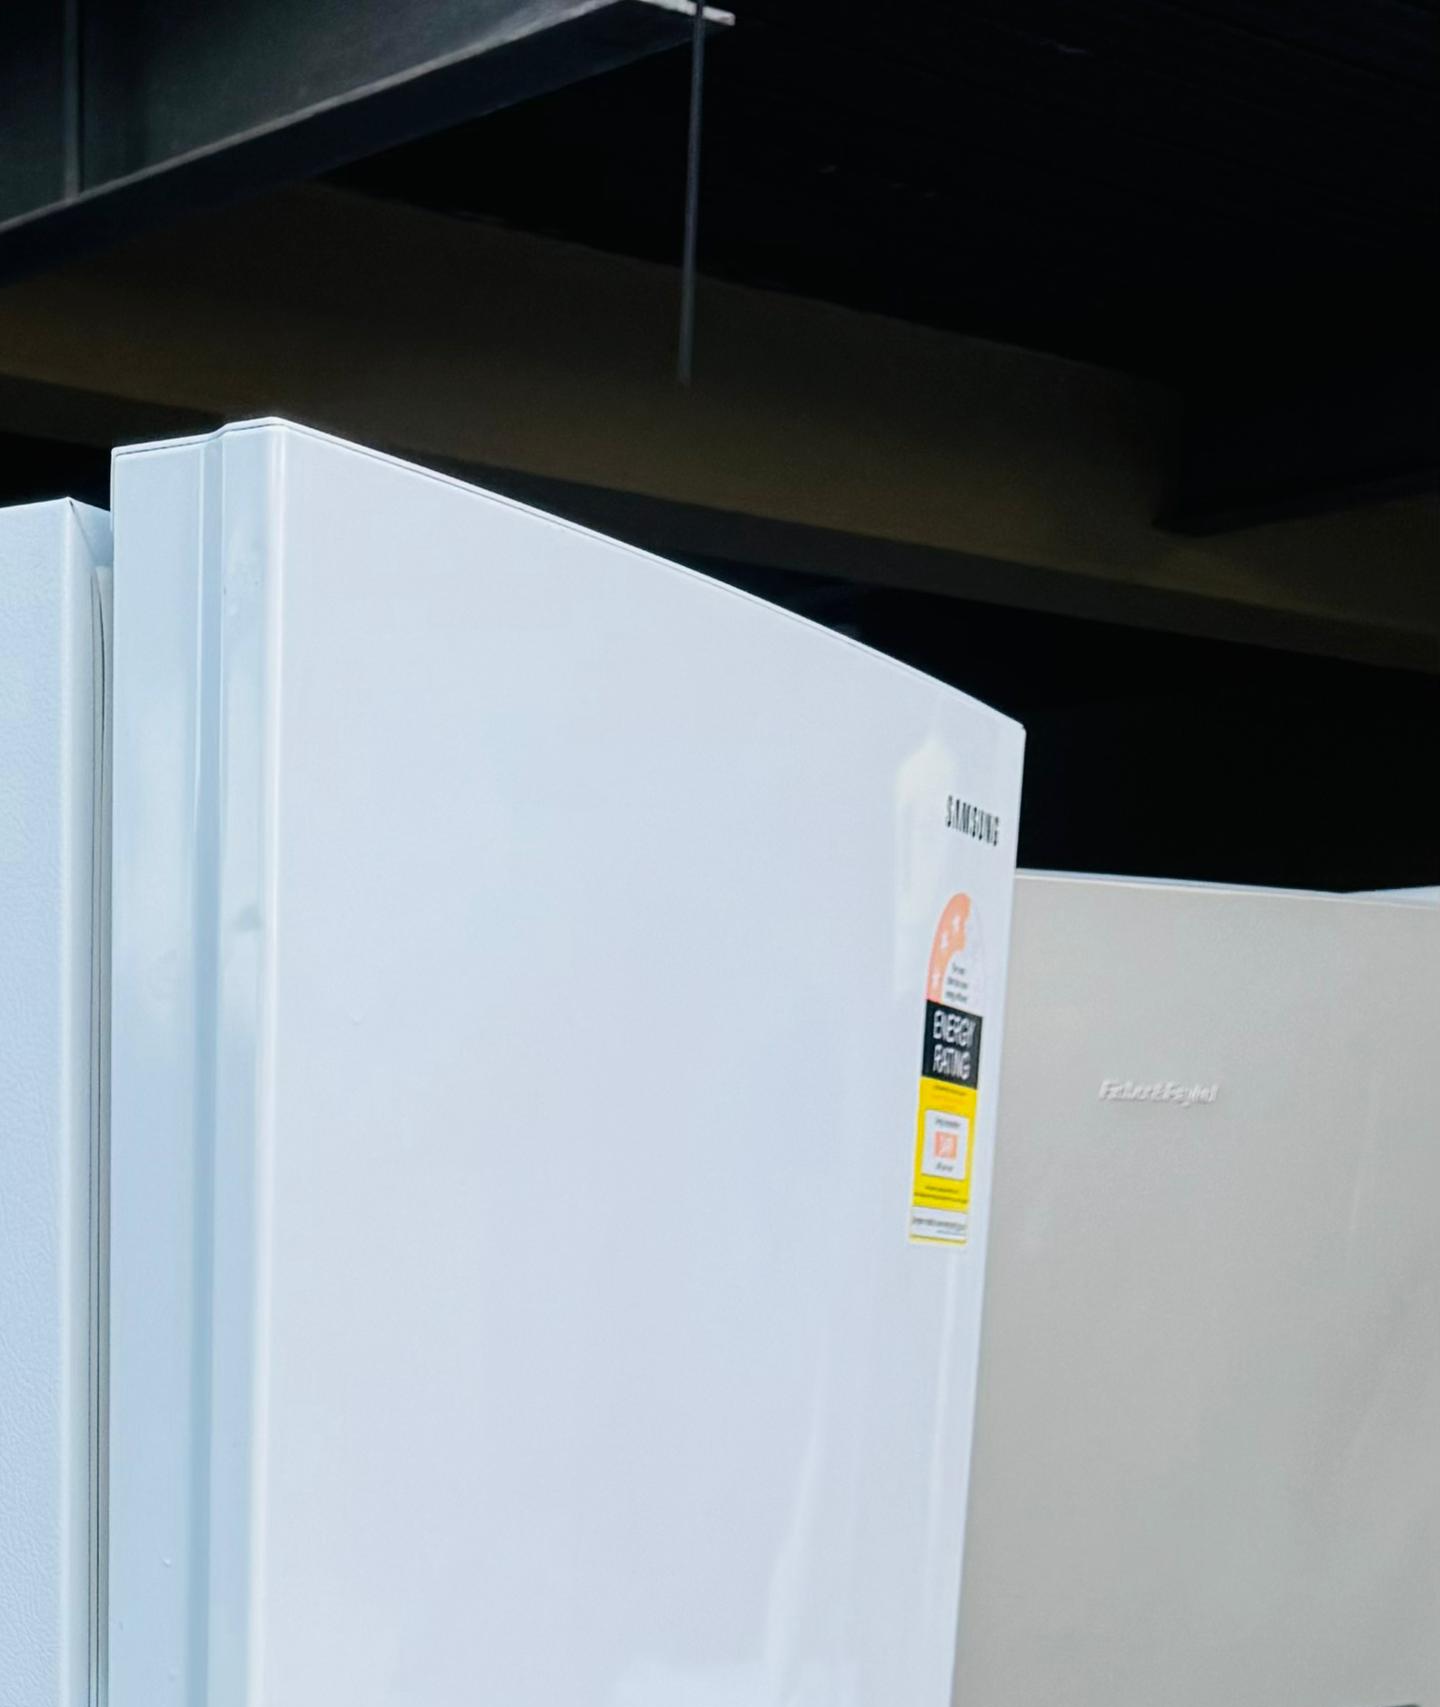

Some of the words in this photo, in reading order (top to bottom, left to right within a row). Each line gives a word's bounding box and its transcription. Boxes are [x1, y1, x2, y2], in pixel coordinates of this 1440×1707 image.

[946, 795, 999, 847] SAMSUNG
[933, 1010, 976, 1047] ENERGY
[933, 1044, 971, 1080] RATING
